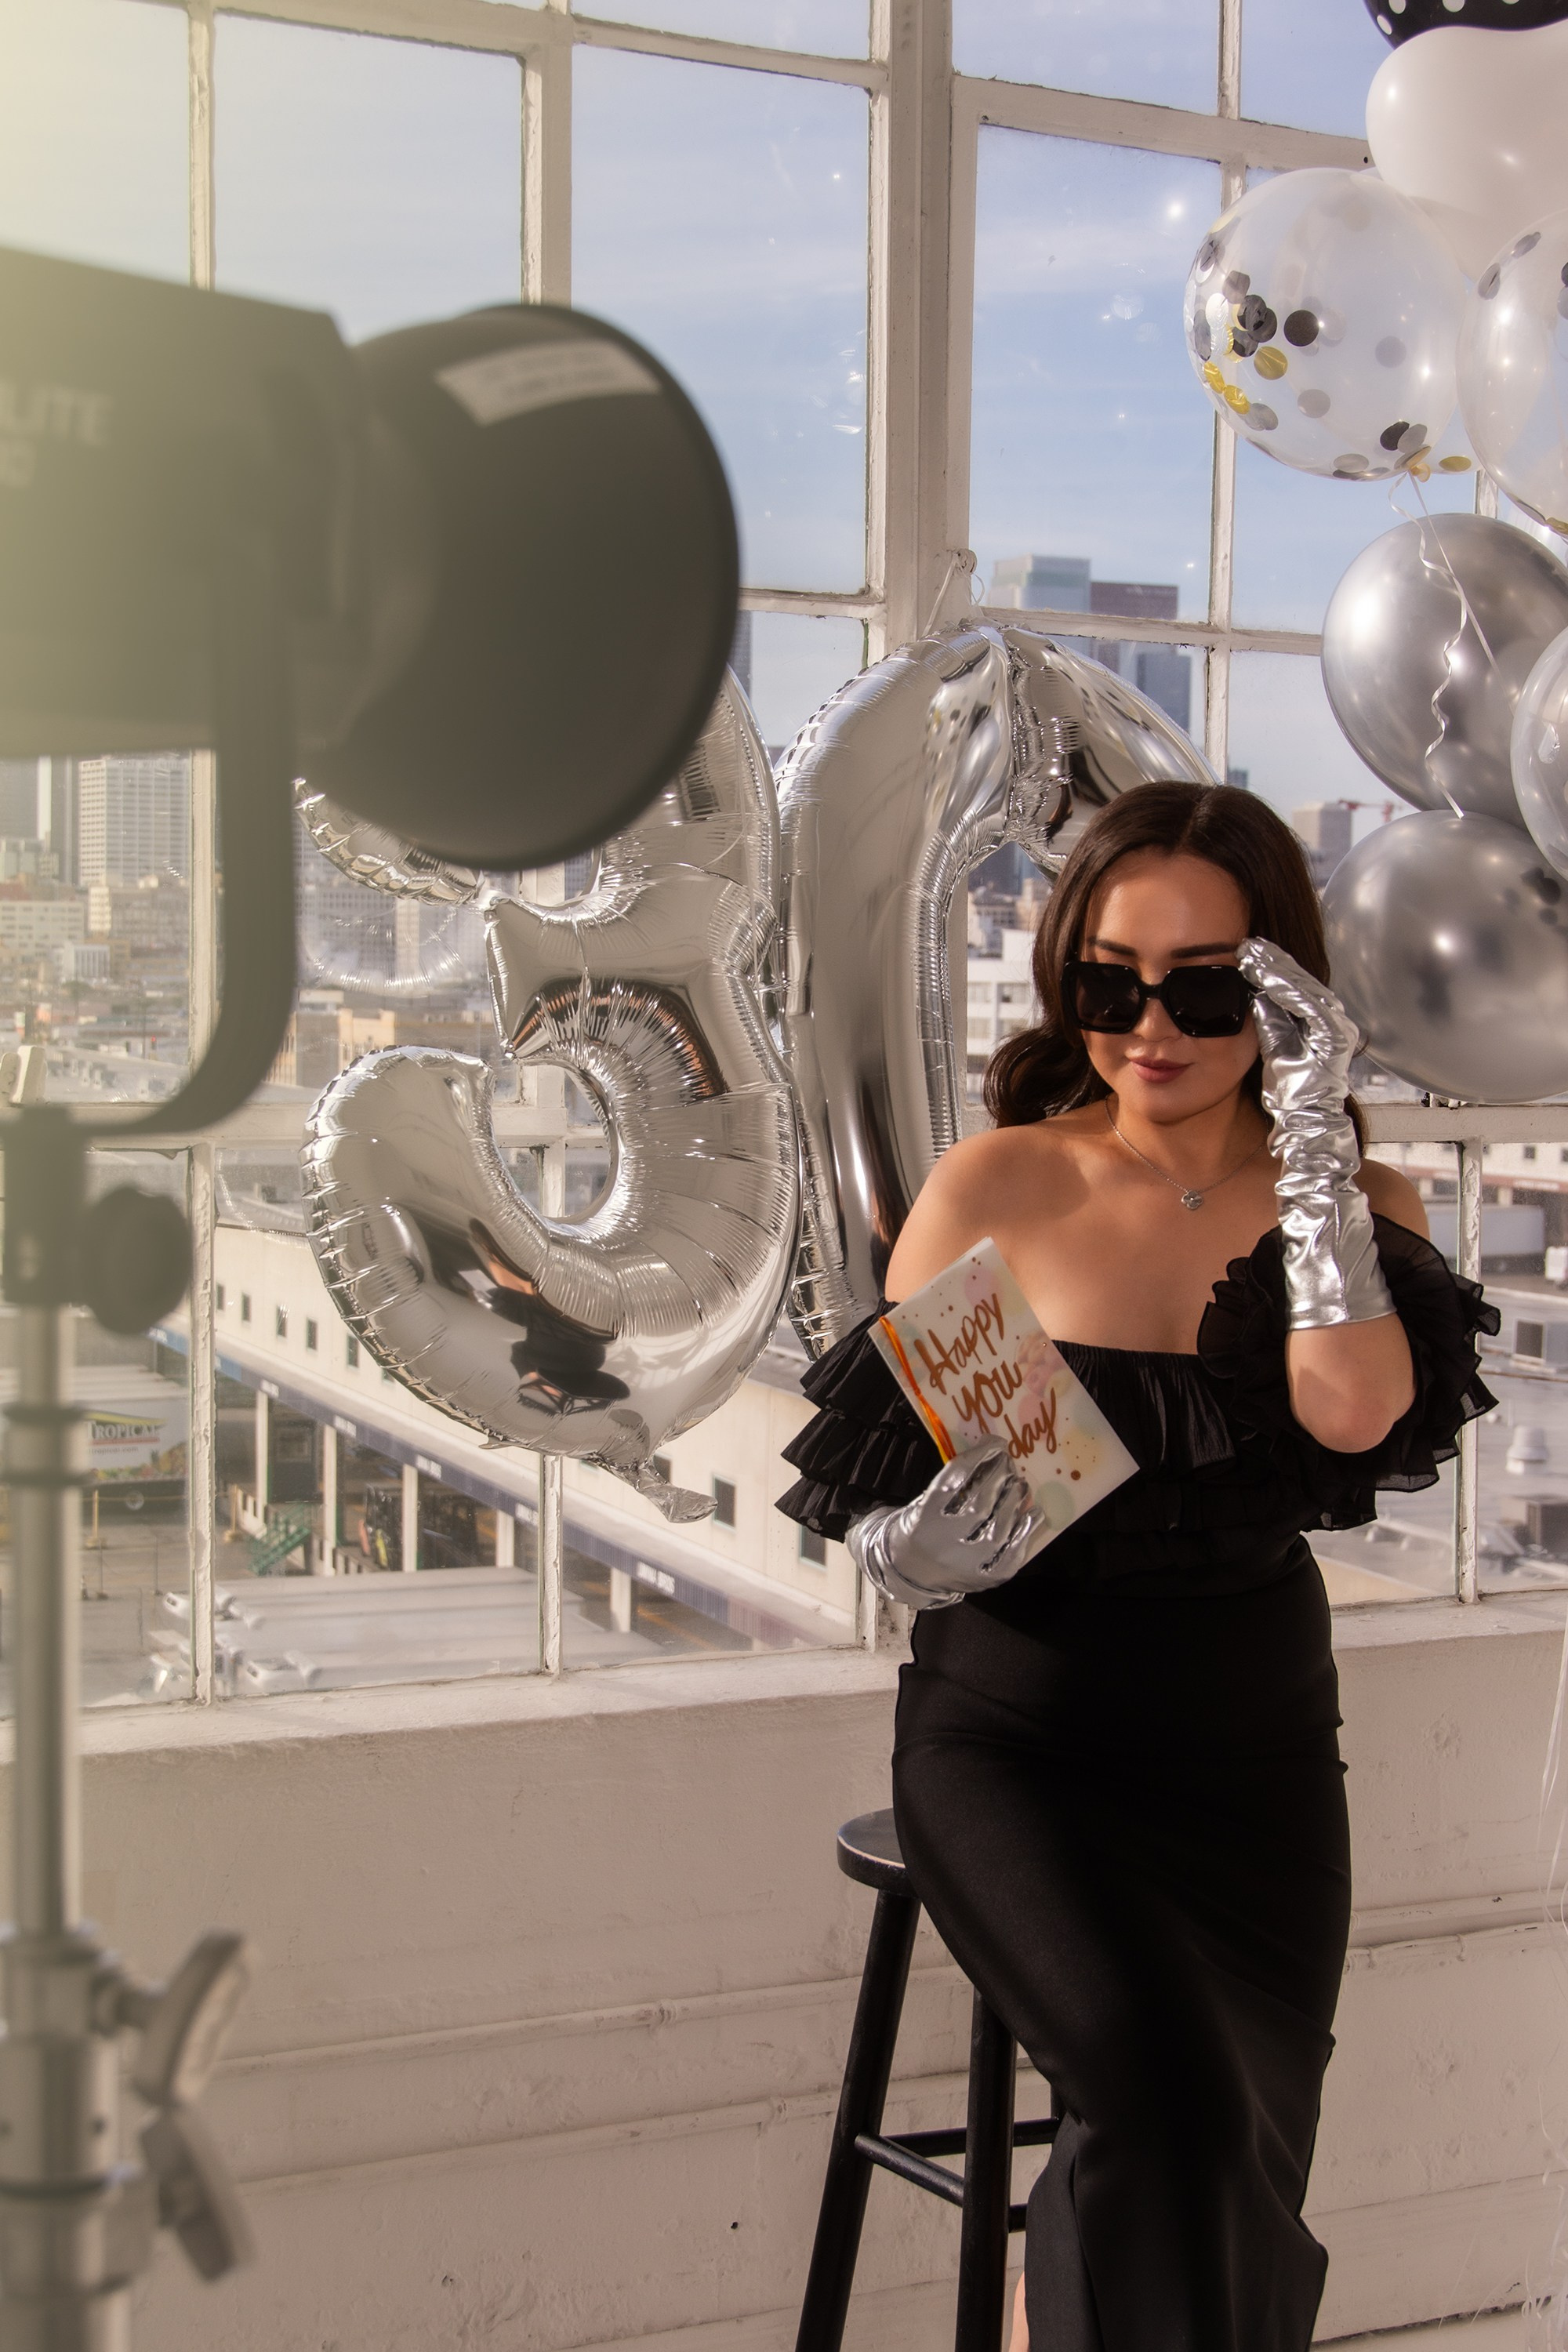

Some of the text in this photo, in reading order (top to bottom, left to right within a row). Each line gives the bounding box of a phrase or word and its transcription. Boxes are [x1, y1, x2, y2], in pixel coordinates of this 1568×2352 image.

[914, 1293, 1004, 1396] Happy
[88, 1421, 158, 1439] TROPICAL
[952, 1361, 1022, 1434] you
[1004, 1388, 1058, 1459] day
